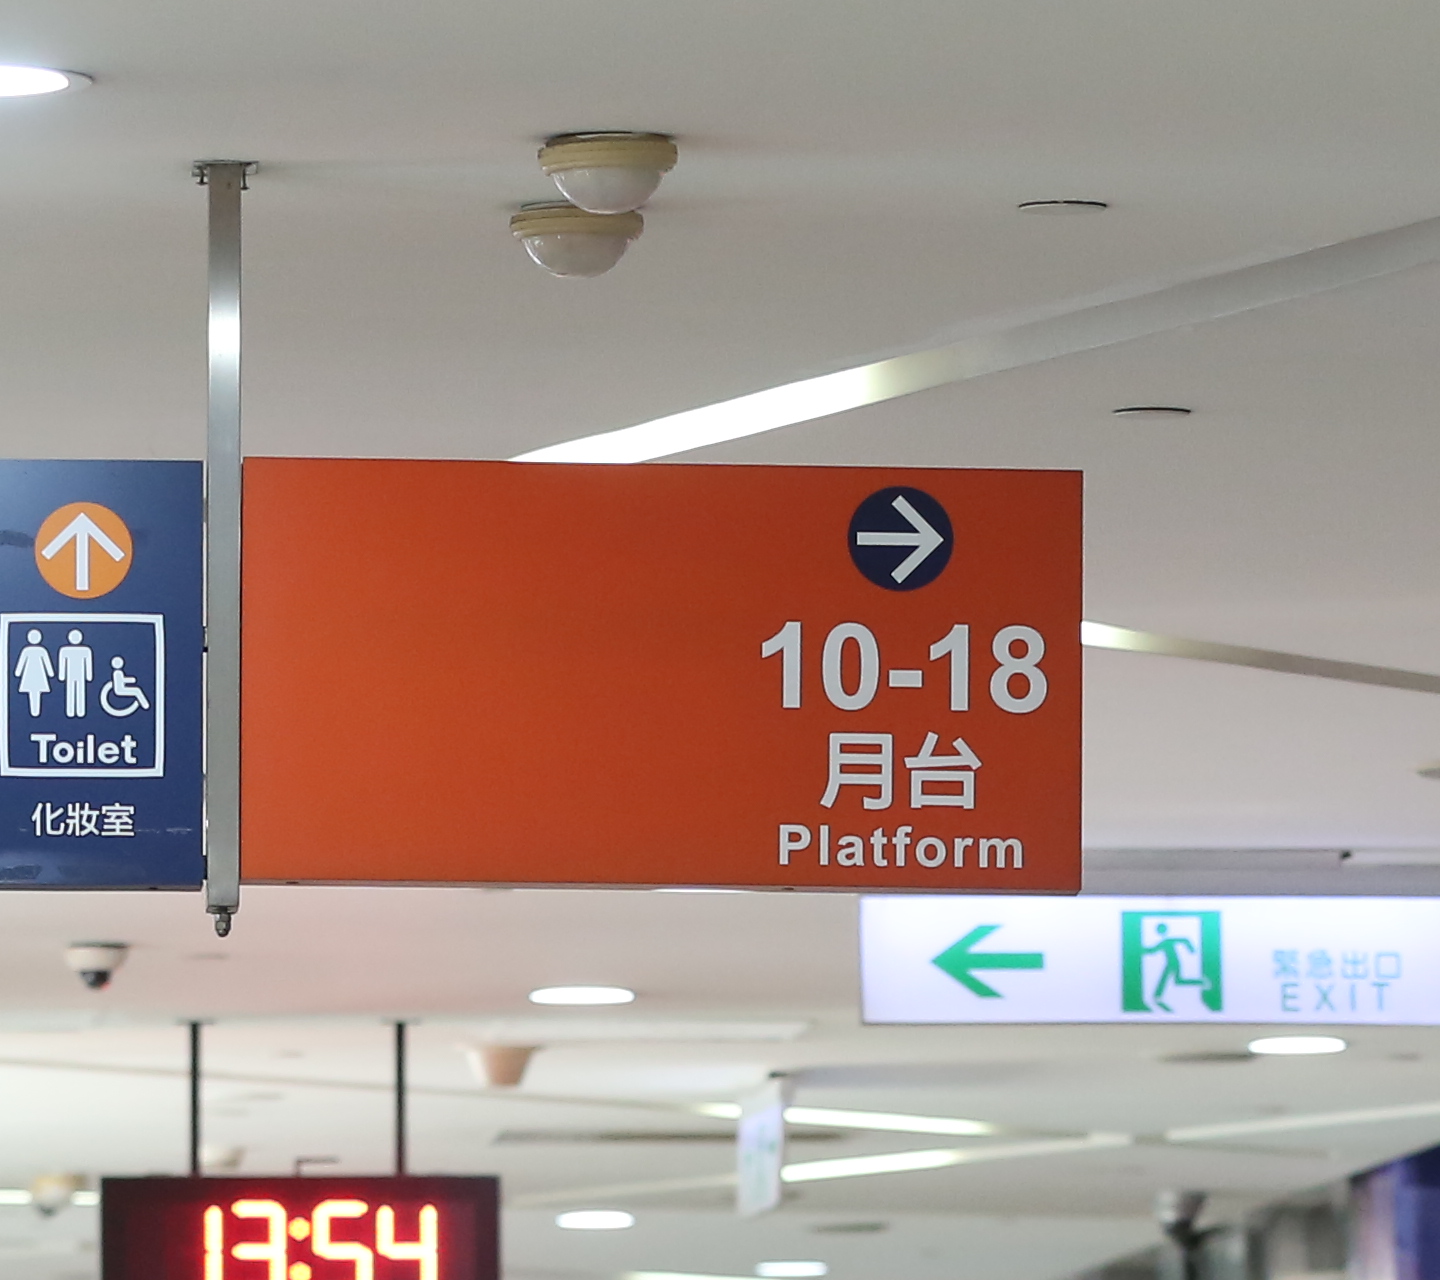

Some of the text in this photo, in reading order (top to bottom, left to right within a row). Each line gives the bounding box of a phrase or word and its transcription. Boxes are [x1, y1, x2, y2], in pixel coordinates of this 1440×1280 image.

[761, 621, 1048, 714] 10-18
[30, 733, 137, 765] Toilet
[820, 731, 982, 811] 月台
[30, 801, 136, 838] 化妝室
[778, 823, 1025, 870] Platform
[1271, 948, 1403, 981] 緊急出口
[1281, 982, 1392, 1012] EXIT
